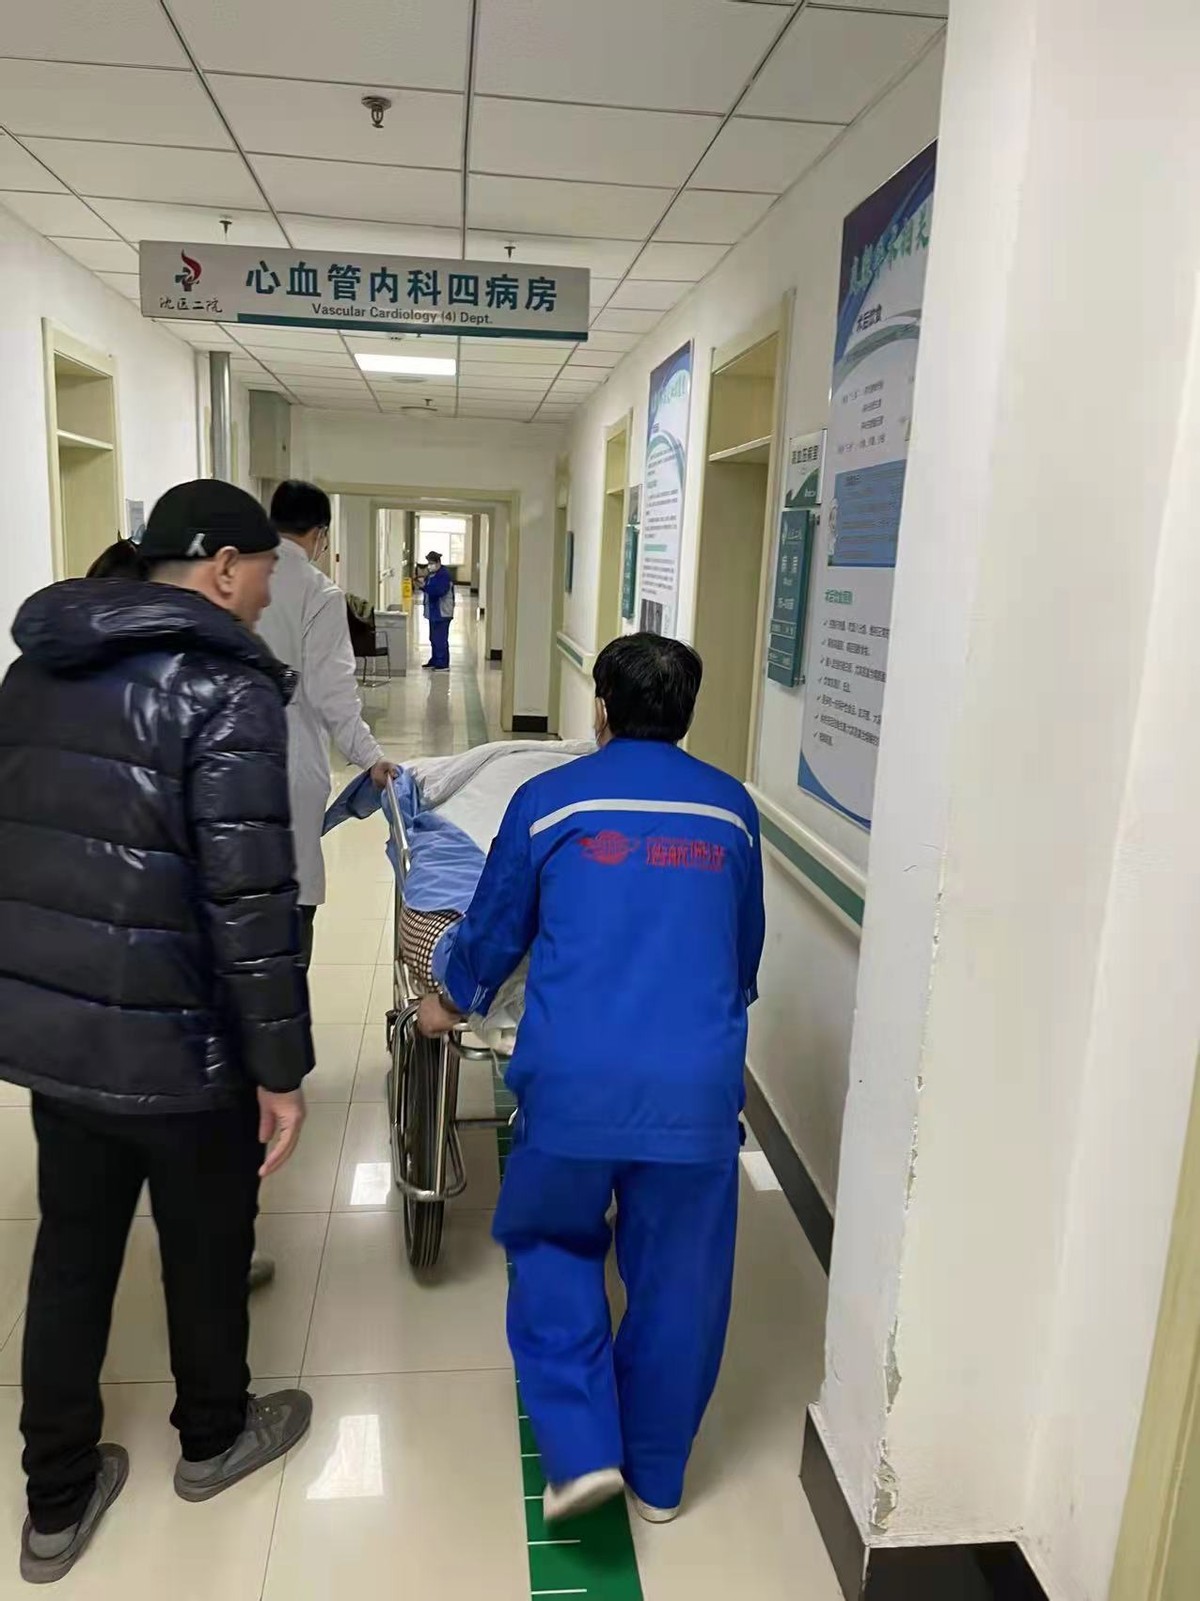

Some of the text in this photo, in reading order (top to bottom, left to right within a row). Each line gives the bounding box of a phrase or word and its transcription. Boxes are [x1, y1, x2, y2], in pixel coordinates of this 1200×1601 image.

[245, 260, 558, 313] 心血管内科四病房
[311, 303, 493, 325] Vascular Cardiology (4) Dept.
